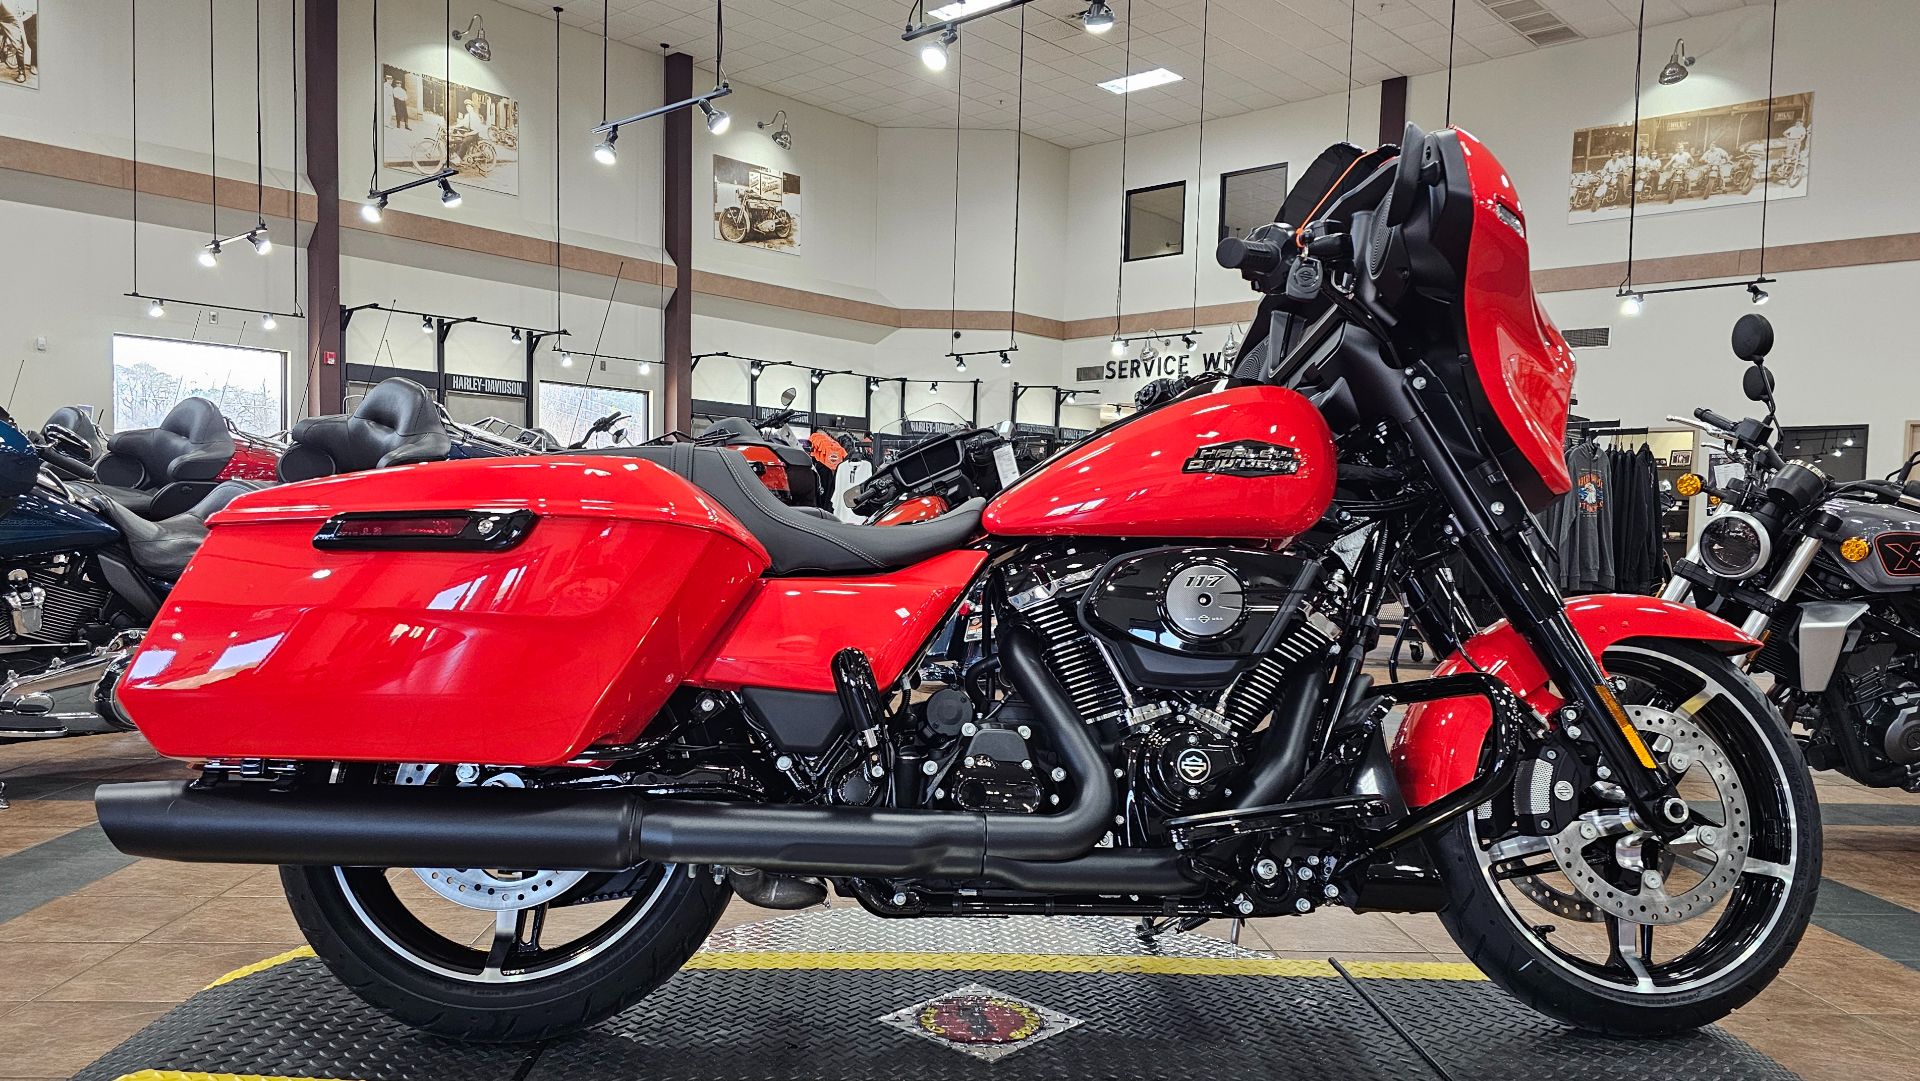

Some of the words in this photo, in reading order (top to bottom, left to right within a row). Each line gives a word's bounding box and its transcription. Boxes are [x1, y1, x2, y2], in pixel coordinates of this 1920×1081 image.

[1105, 354, 1190, 379] SERVICE
[452, 375, 523, 395] HARLEY-DAVIDSON
[1184, 574, 1227, 588] 117
